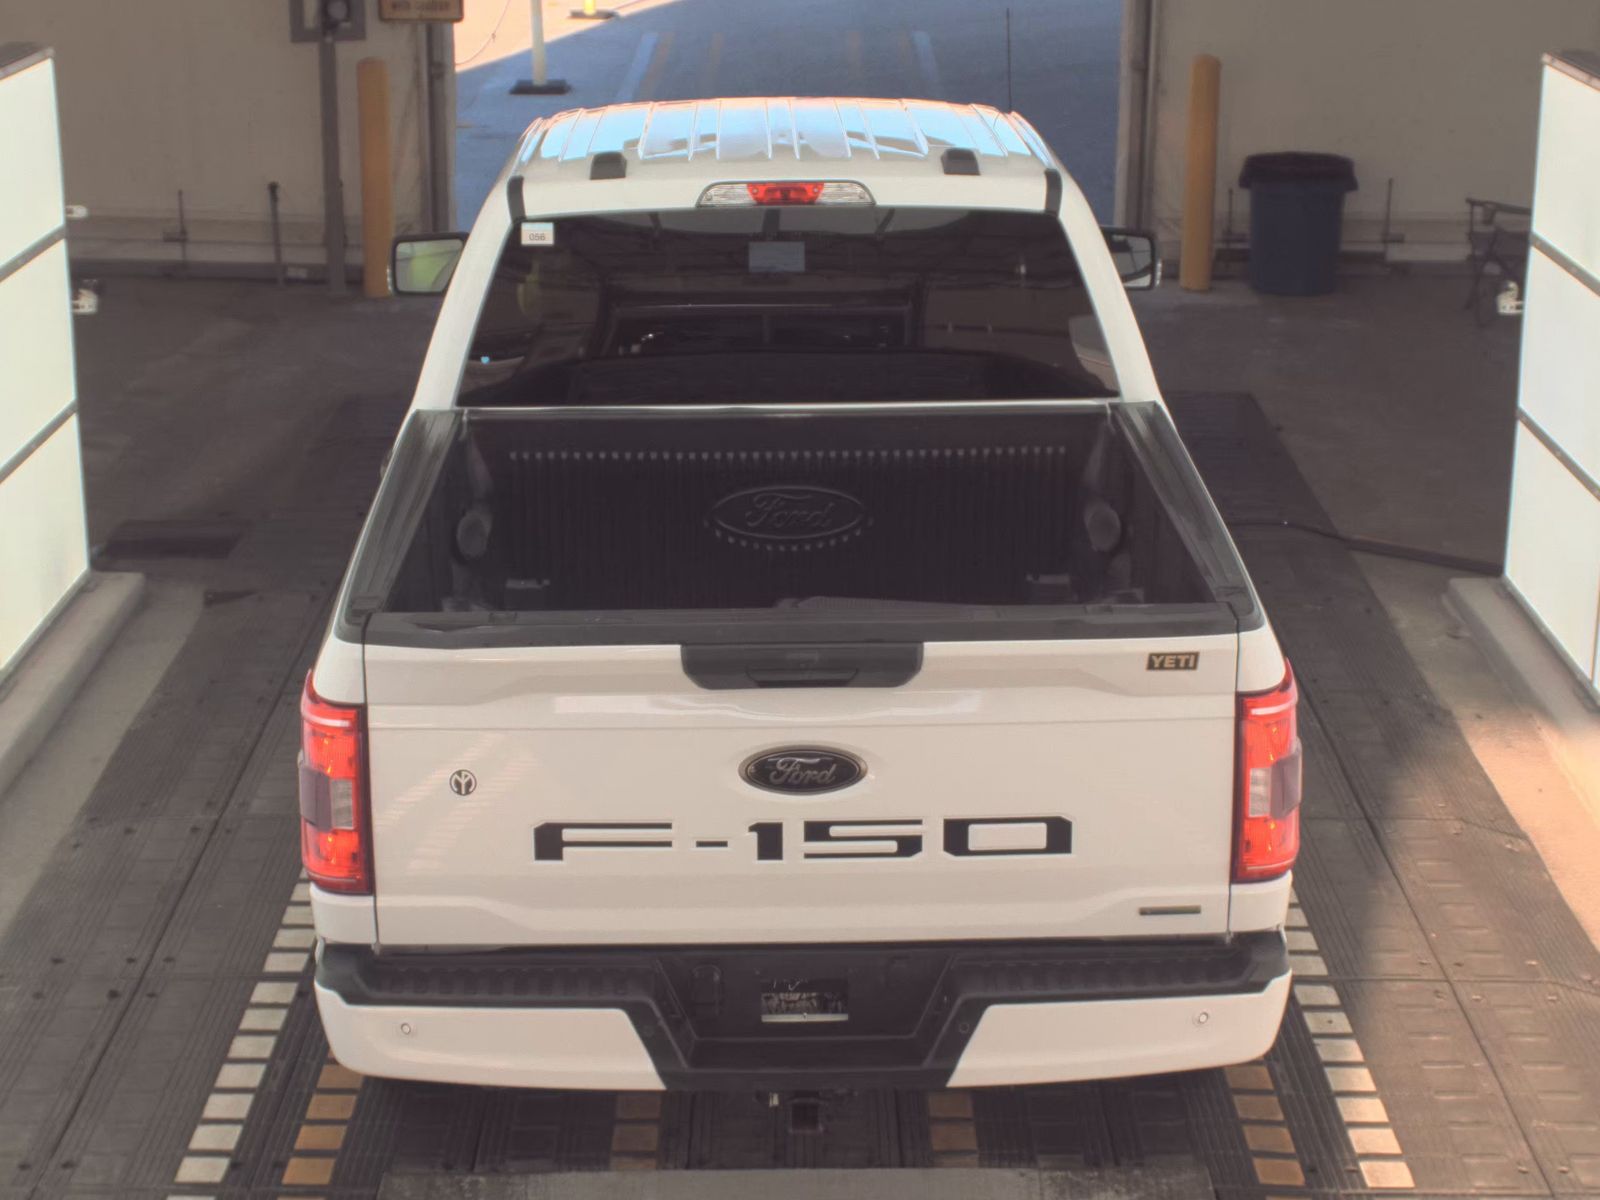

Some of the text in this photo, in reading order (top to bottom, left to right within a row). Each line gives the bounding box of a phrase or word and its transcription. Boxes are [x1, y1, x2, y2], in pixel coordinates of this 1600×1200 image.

[744, 491, 836, 529] Ford
[1151, 654, 1196, 668] YETI
[768, 756, 837, 785] Ford
[534, 816, 1072, 861] F-150
